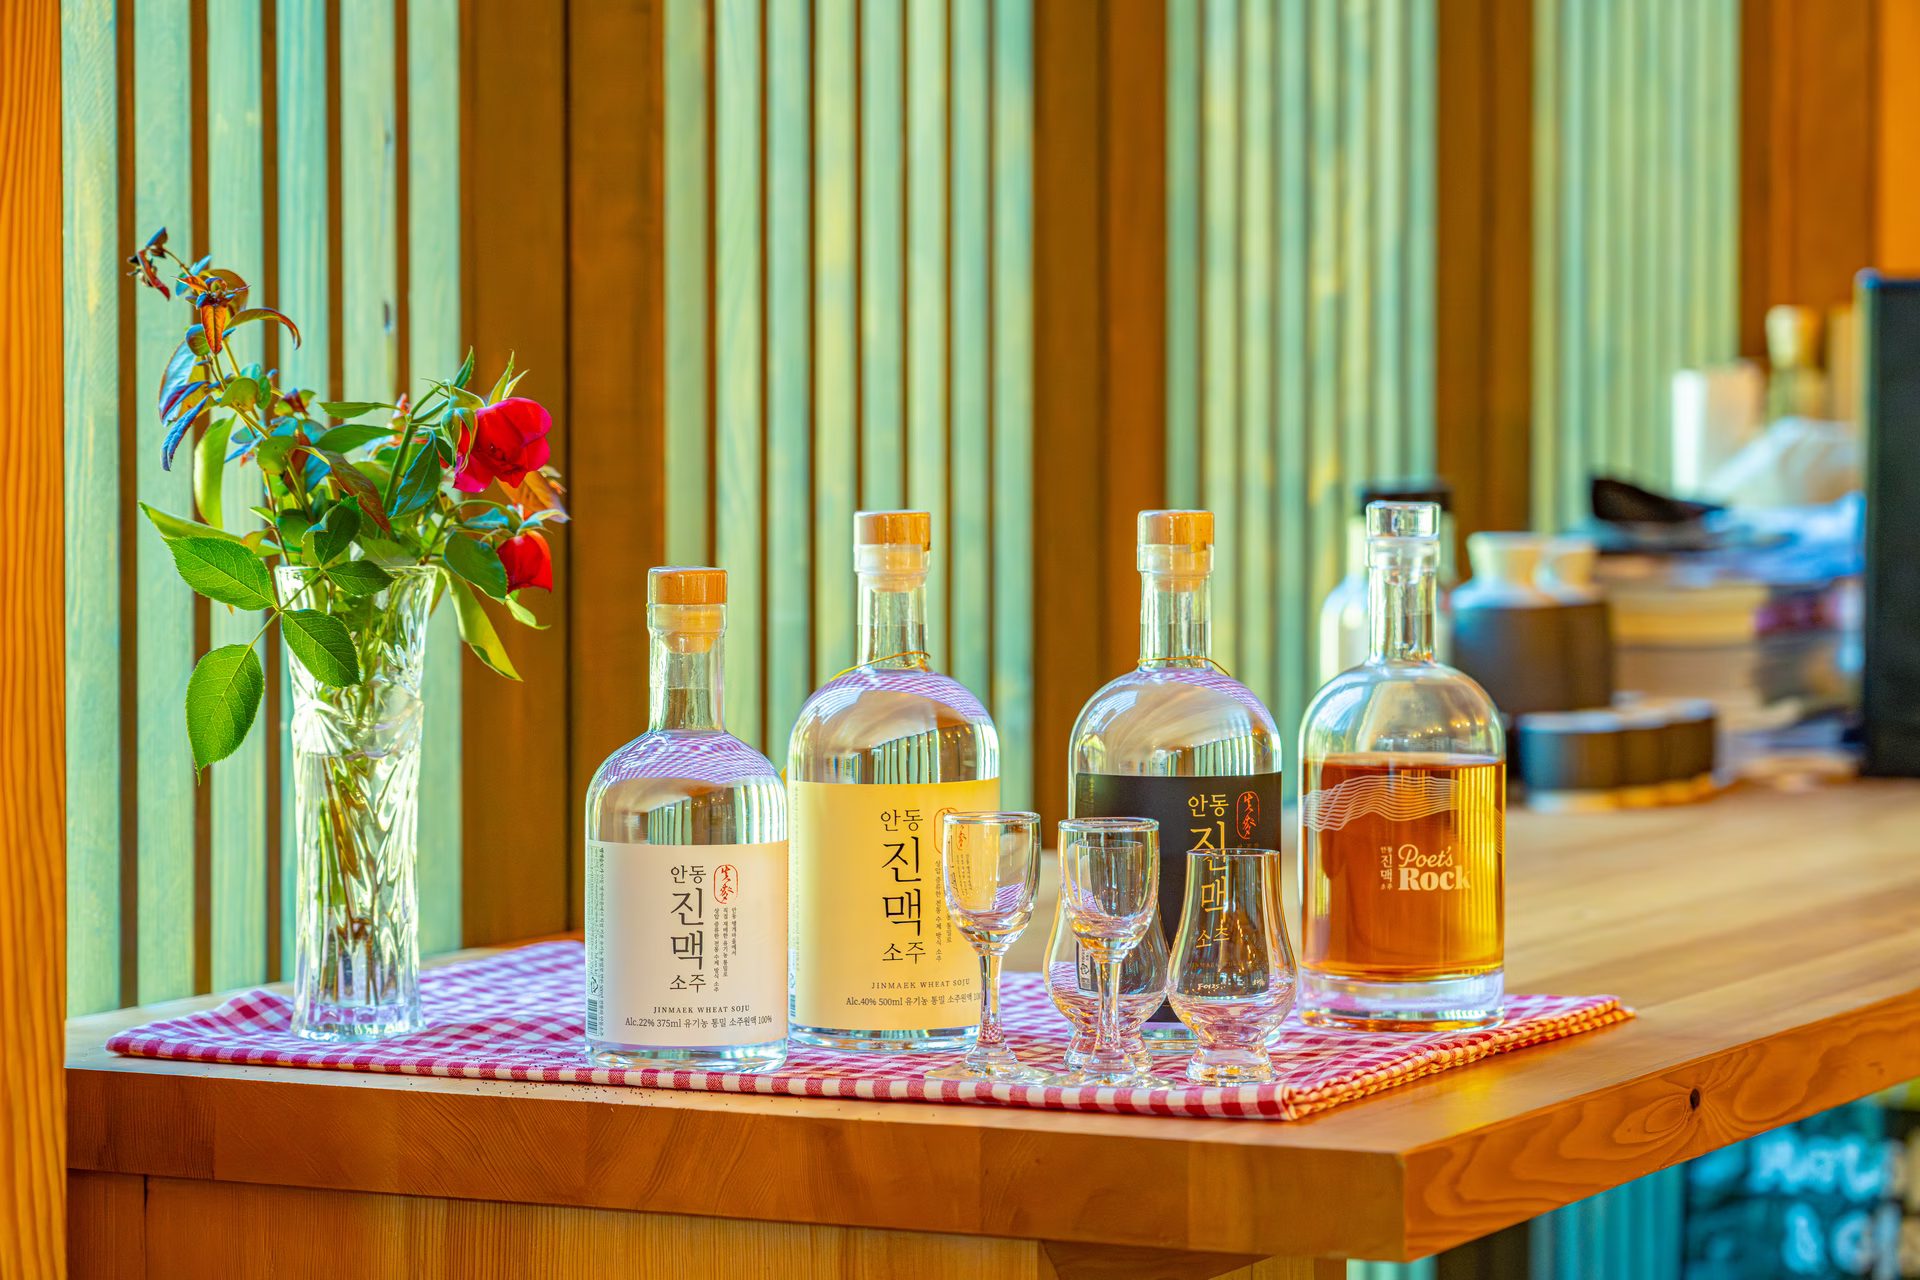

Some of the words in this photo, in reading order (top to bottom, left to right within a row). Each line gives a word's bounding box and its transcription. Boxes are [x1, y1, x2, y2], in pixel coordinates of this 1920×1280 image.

[1187, 793, 1229, 818] 안동
[880, 808, 923, 832] 안동
[1380, 846, 1393, 854] 안동
[1397, 843, 1454, 868] Poet's
[670, 864, 707, 884] 안동
[1397, 865, 1471, 891] Rock
[881, 836, 922, 937] 진맥
[670, 887, 704, 970] 진맥
[882, 941, 926, 965] 소주
[669, 974, 707, 993] 소주
[871, 981, 916, 990] JINMAEK
[920, 980, 950, 988] WHEAT
[952, 978, 970, 988] SOJU
[653, 1006, 694, 1014] JINMAEK
[731, 1004, 751, 1013] SOJU
[846, 996, 877, 1006] Alc.40%
[878, 996, 903, 1006] 500ml
[905, 996, 929, 1007] 유기농
[931, 996, 946, 1006] 통밀
[947, 994, 973, 1005] 소주원액
[625, 1017, 655, 1028] Alc.22%
[656, 1016, 682, 1028] 375ml
[684, 1016, 709, 1029] 유기농
[711, 1017, 727, 1028] 통밀
[729, 1016, 757, 1027] 소주원액
[758, 1016, 772, 1025] 100%
